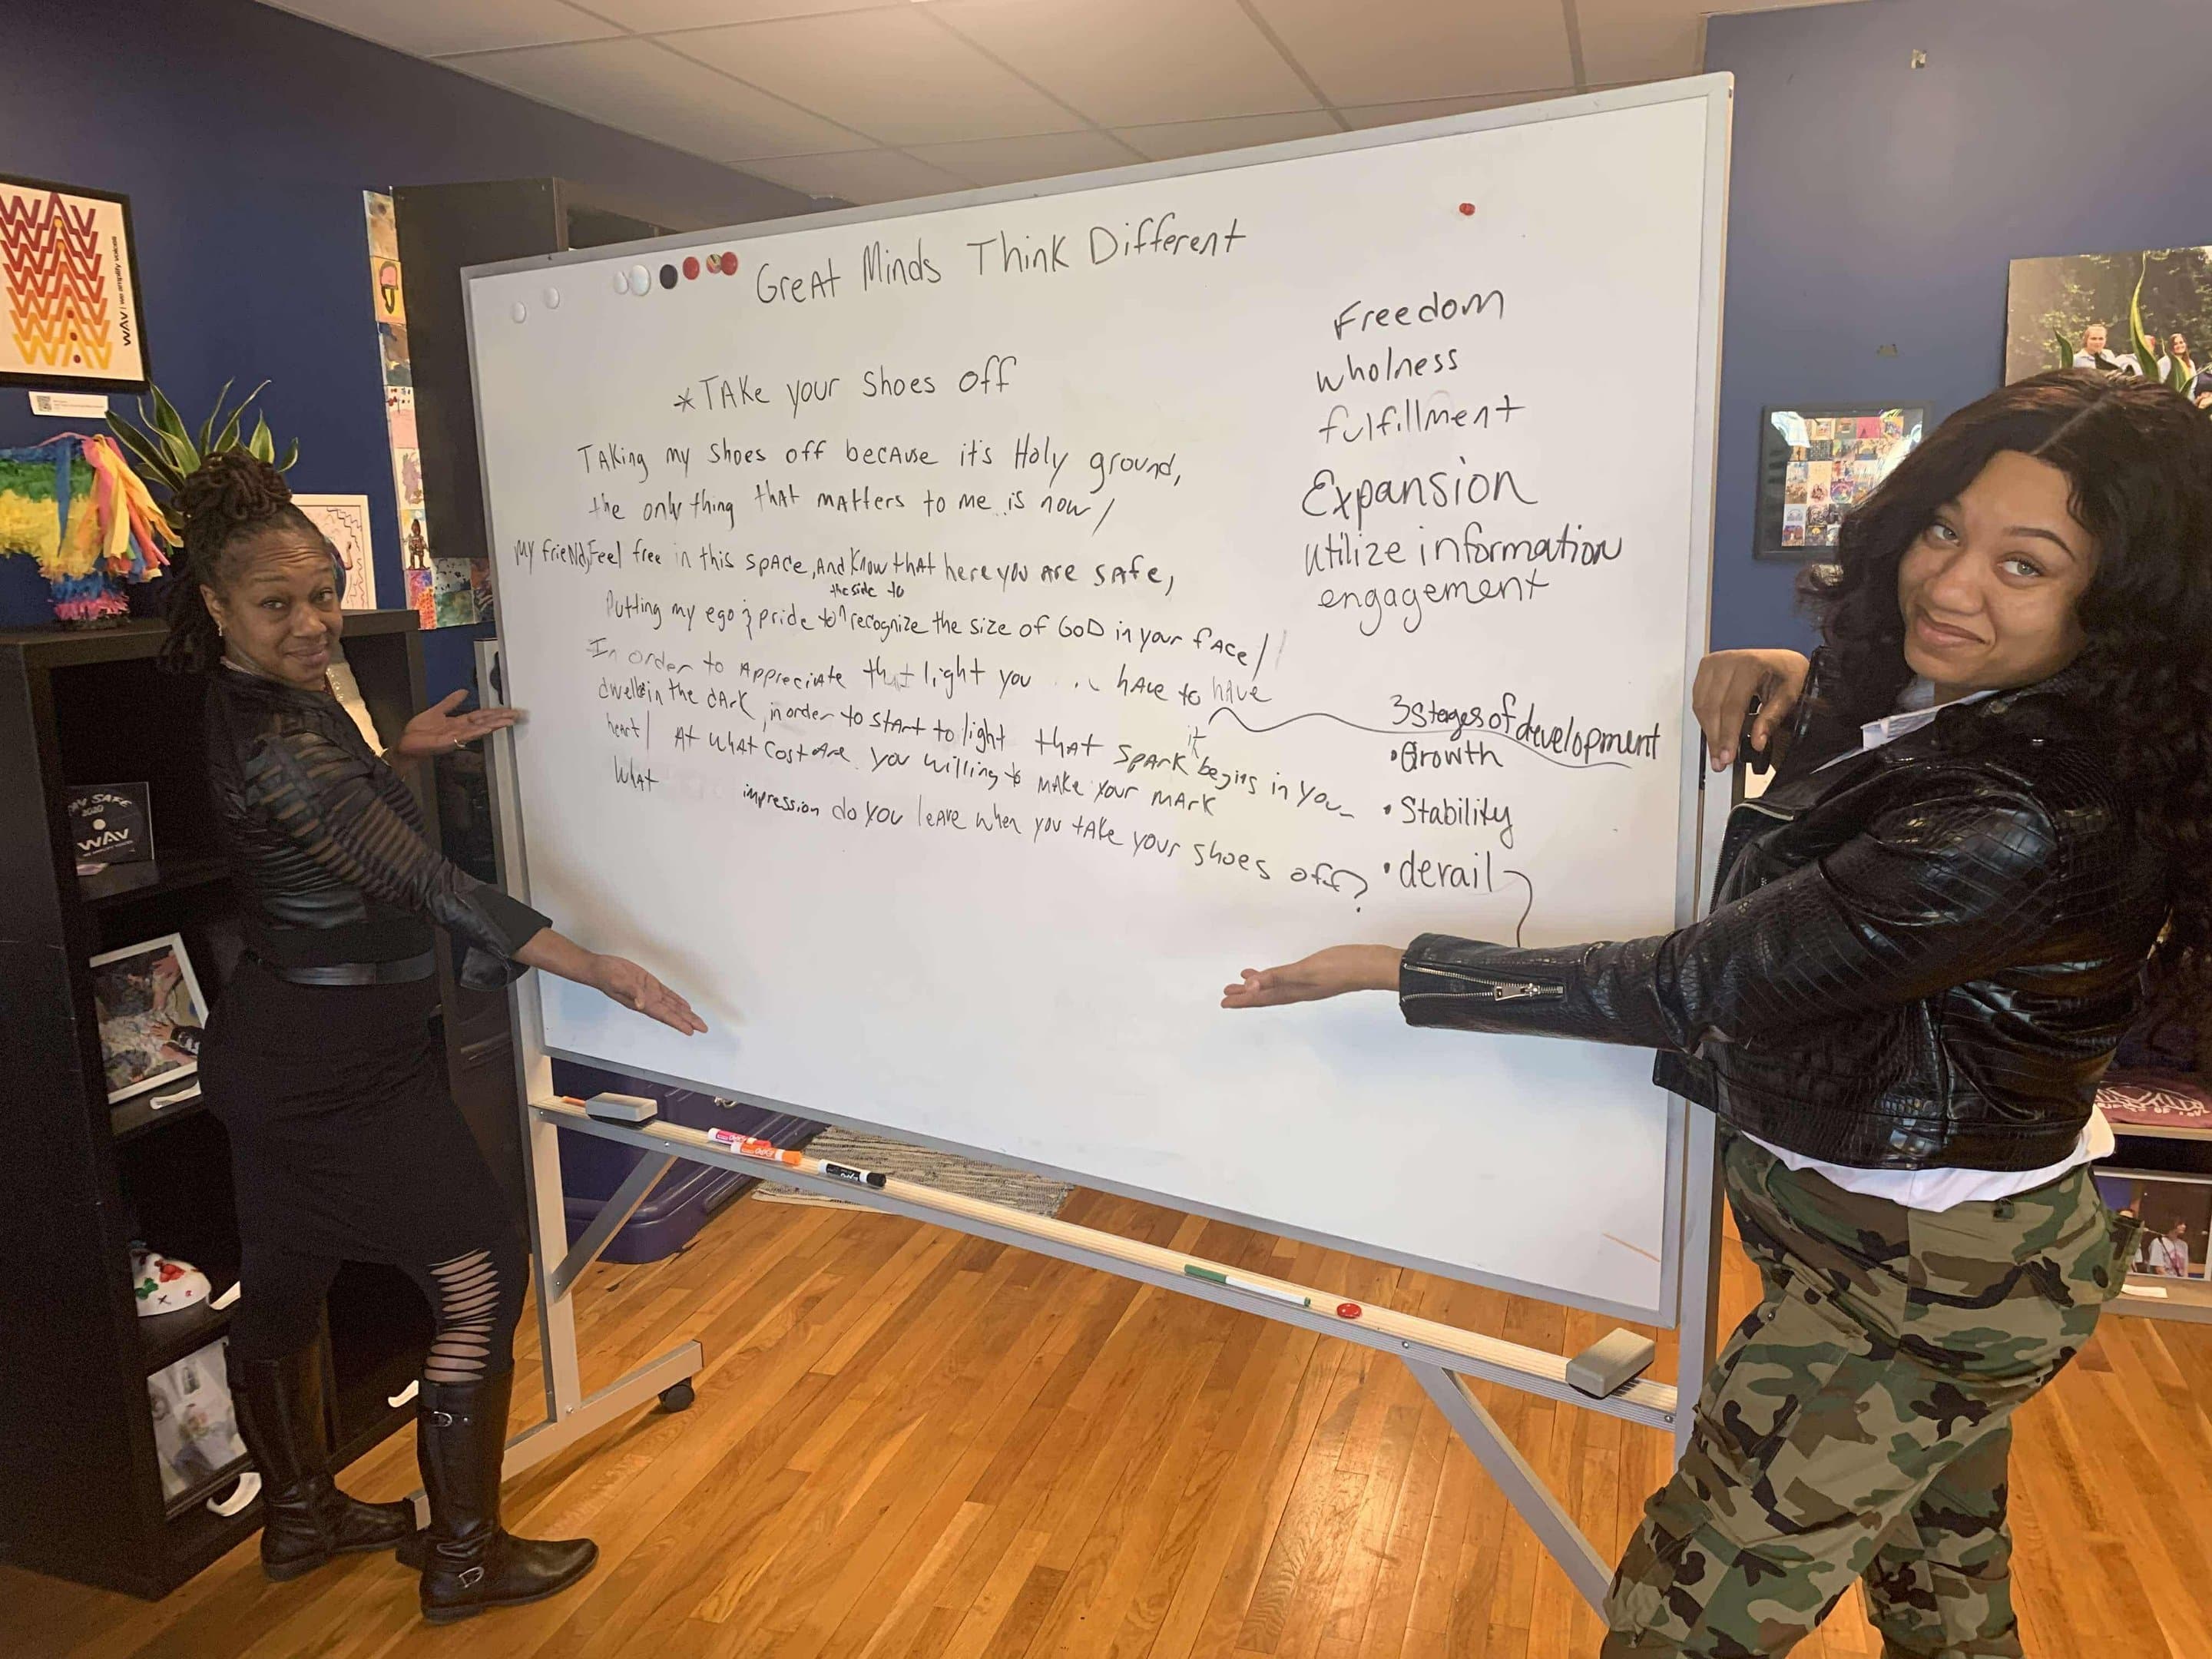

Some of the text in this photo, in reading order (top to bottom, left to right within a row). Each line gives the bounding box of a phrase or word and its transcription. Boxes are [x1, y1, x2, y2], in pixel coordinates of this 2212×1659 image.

[863, 238, 942, 290] Minds
[1090, 212, 1247, 264] Different
[1334, 290, 1505, 340] Freedom
[786, 377, 839, 419] your
[1319, 394, 1526, 444] fulfillment
[786, 439, 827, 462] off
[961, 439, 992, 467] it's
[1015, 432, 1068, 488] Holy
[588, 493, 625, 520] the
[644, 491, 681, 522] only
[690, 488, 734, 531] thing
[923, 489, 945, 517] to
[1302, 455, 1538, 531] Expansion
[633, 538, 662, 565] free
[675, 542, 691, 568] in
[700, 543, 734, 571] this
[945, 552, 993, 581] here
[997, 563, 1028, 593] you
[1419, 522, 1622, 566] information
[887, 581, 906, 598] to
[1318, 568, 1549, 637] engagement
[706, 606, 733, 632] ego
[759, 603, 814, 631] pride
[850, 614, 929, 642] recognize
[932, 610, 962, 634] the
[970, 617, 1012, 636] size
[1019, 614, 1050, 637] of
[1116, 621, 1131, 643] in
[1141, 628, 1183, 653] your
[703, 651, 724, 676] to
[925, 654, 986, 700] light
[999, 668, 1031, 700] you
[1178, 683, 1201, 706] to
[669, 677, 698, 705] the
[786, 702, 835, 722] order
[840, 704, 863, 727] to
[933, 719, 954, 742] to
[962, 712, 1006, 753] light
[1272, 772, 1288, 800] in
[1488, 692, 1516, 733] of
[1515, 703, 1661, 765] development
[1401, 740, 1504, 773] Growth
[77, 828, 129, 850] WAV
[743, 783, 820, 816] impression
[832, 796, 857, 821] do
[975, 803, 1022, 835] when
[1133, 830, 1181, 858] your
[1401, 796, 1513, 849] Stability
[1399, 849, 1493, 892] derail
